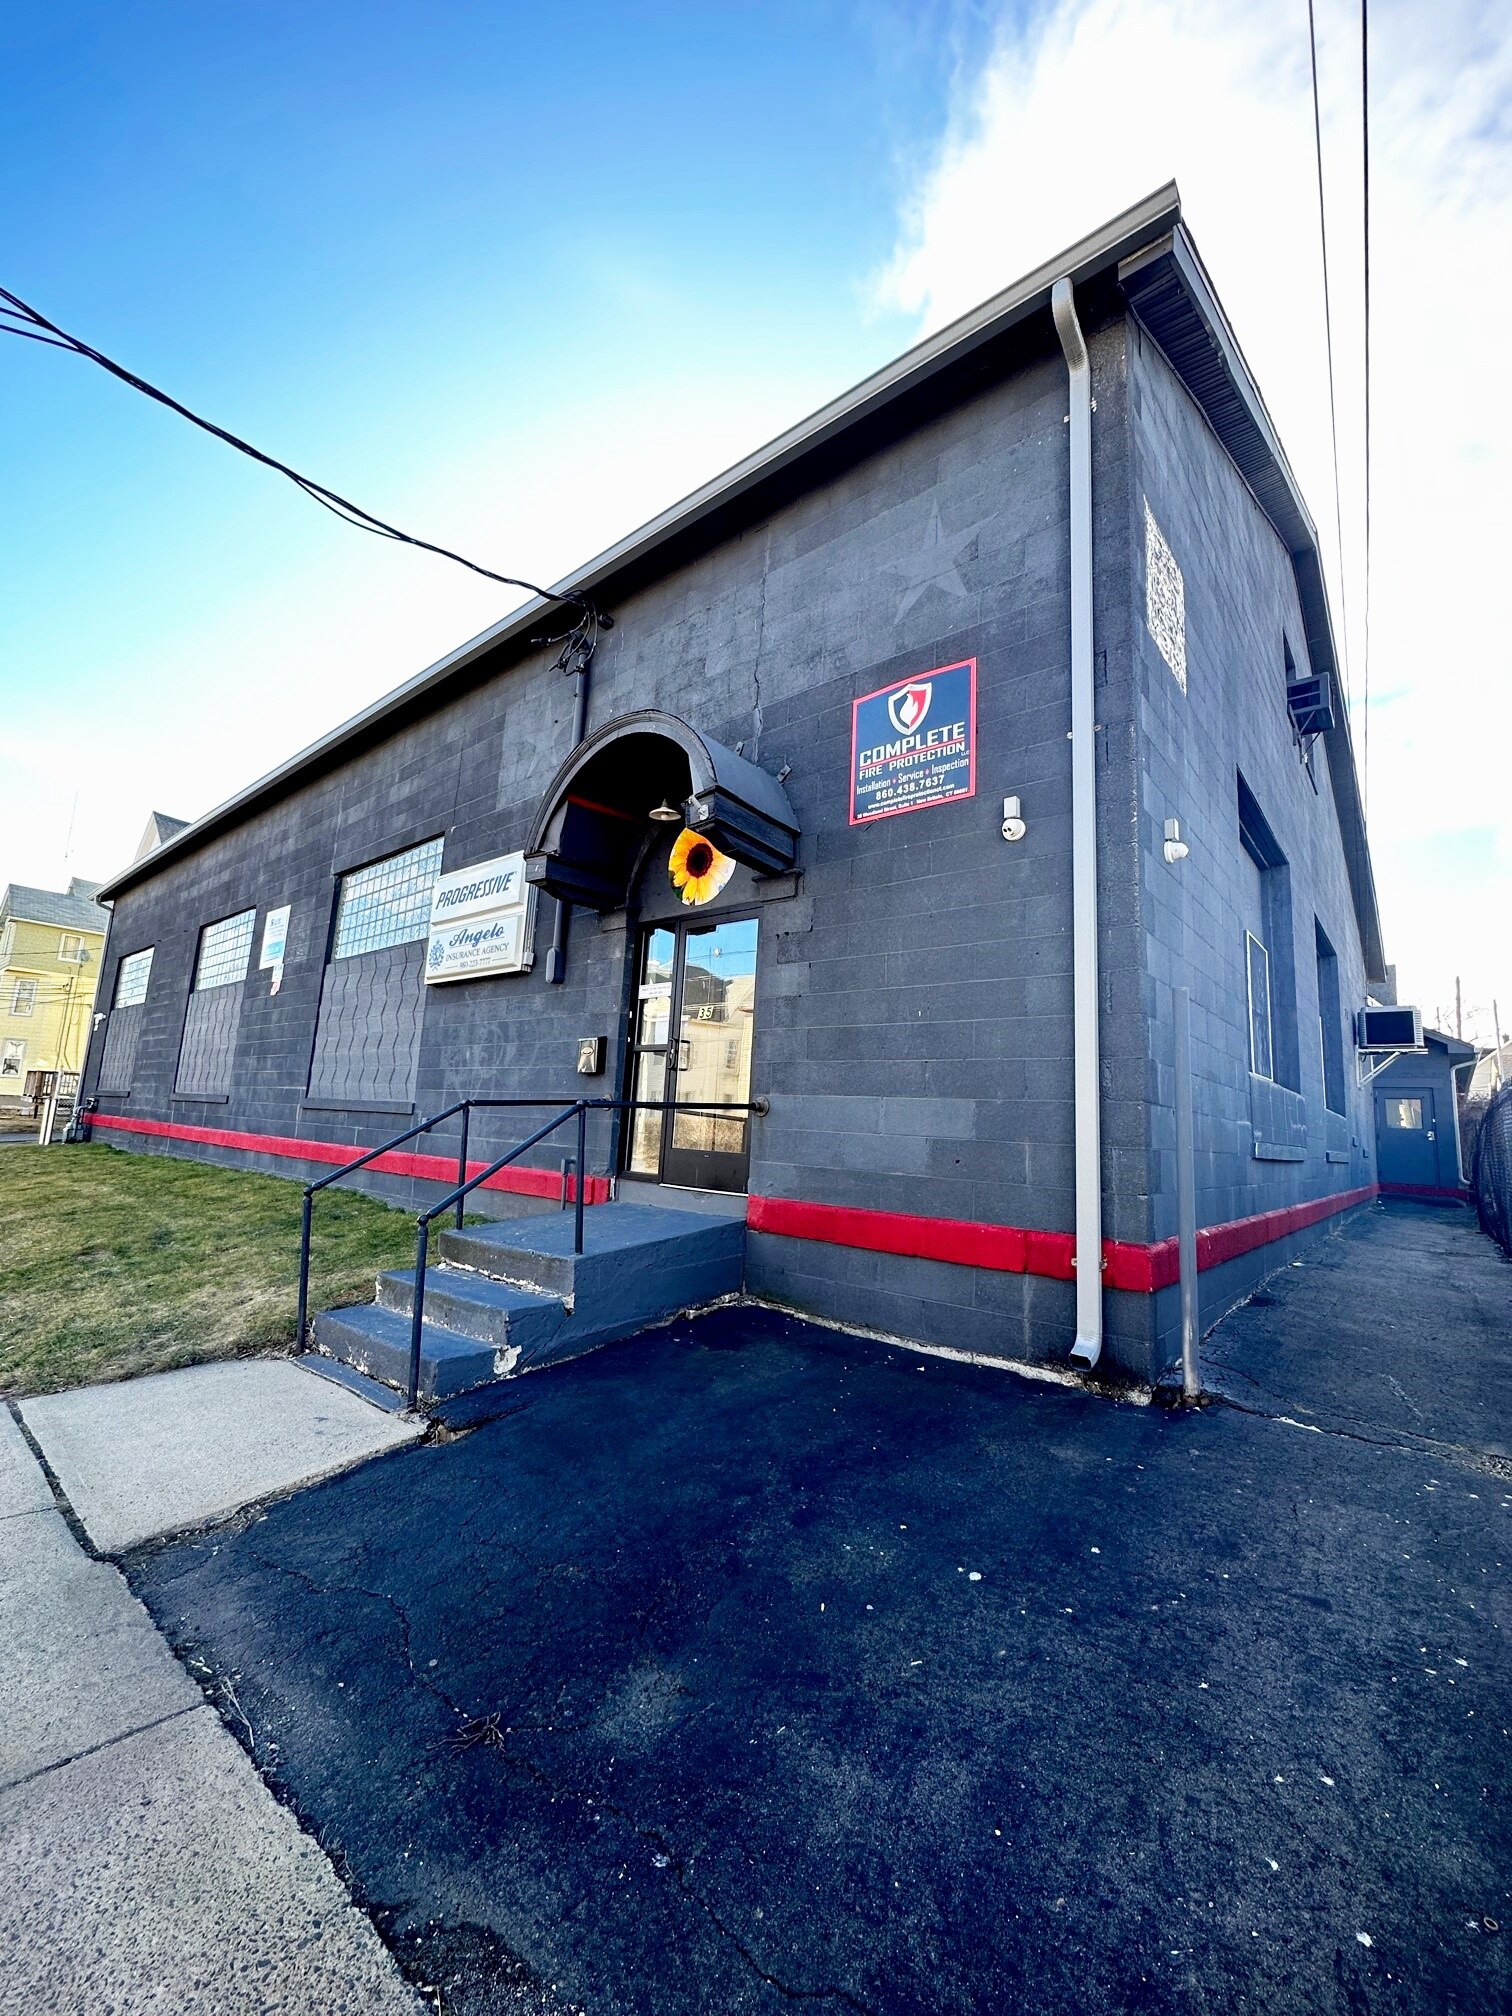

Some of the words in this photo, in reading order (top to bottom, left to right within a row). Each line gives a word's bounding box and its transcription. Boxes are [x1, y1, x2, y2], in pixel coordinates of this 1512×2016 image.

[859, 721, 965, 767] COMPLETE
[859, 764, 882, 780] FIRE
[889, 741, 965, 771] PROTECTION
[856, 779, 891, 795] Installation
[898, 769, 924, 784] Service
[931, 758, 969, 775] Inspection
[875, 774, 945, 800] 860.438.7637
[435, 871, 516, 910] PROGRESSIVE
[448, 922, 505, 948] Angelo
[446, 947, 481, 962] INSURANCE
[481, 942, 510, 955] AGENCY
[699, 1007, 712, 1018] 35
